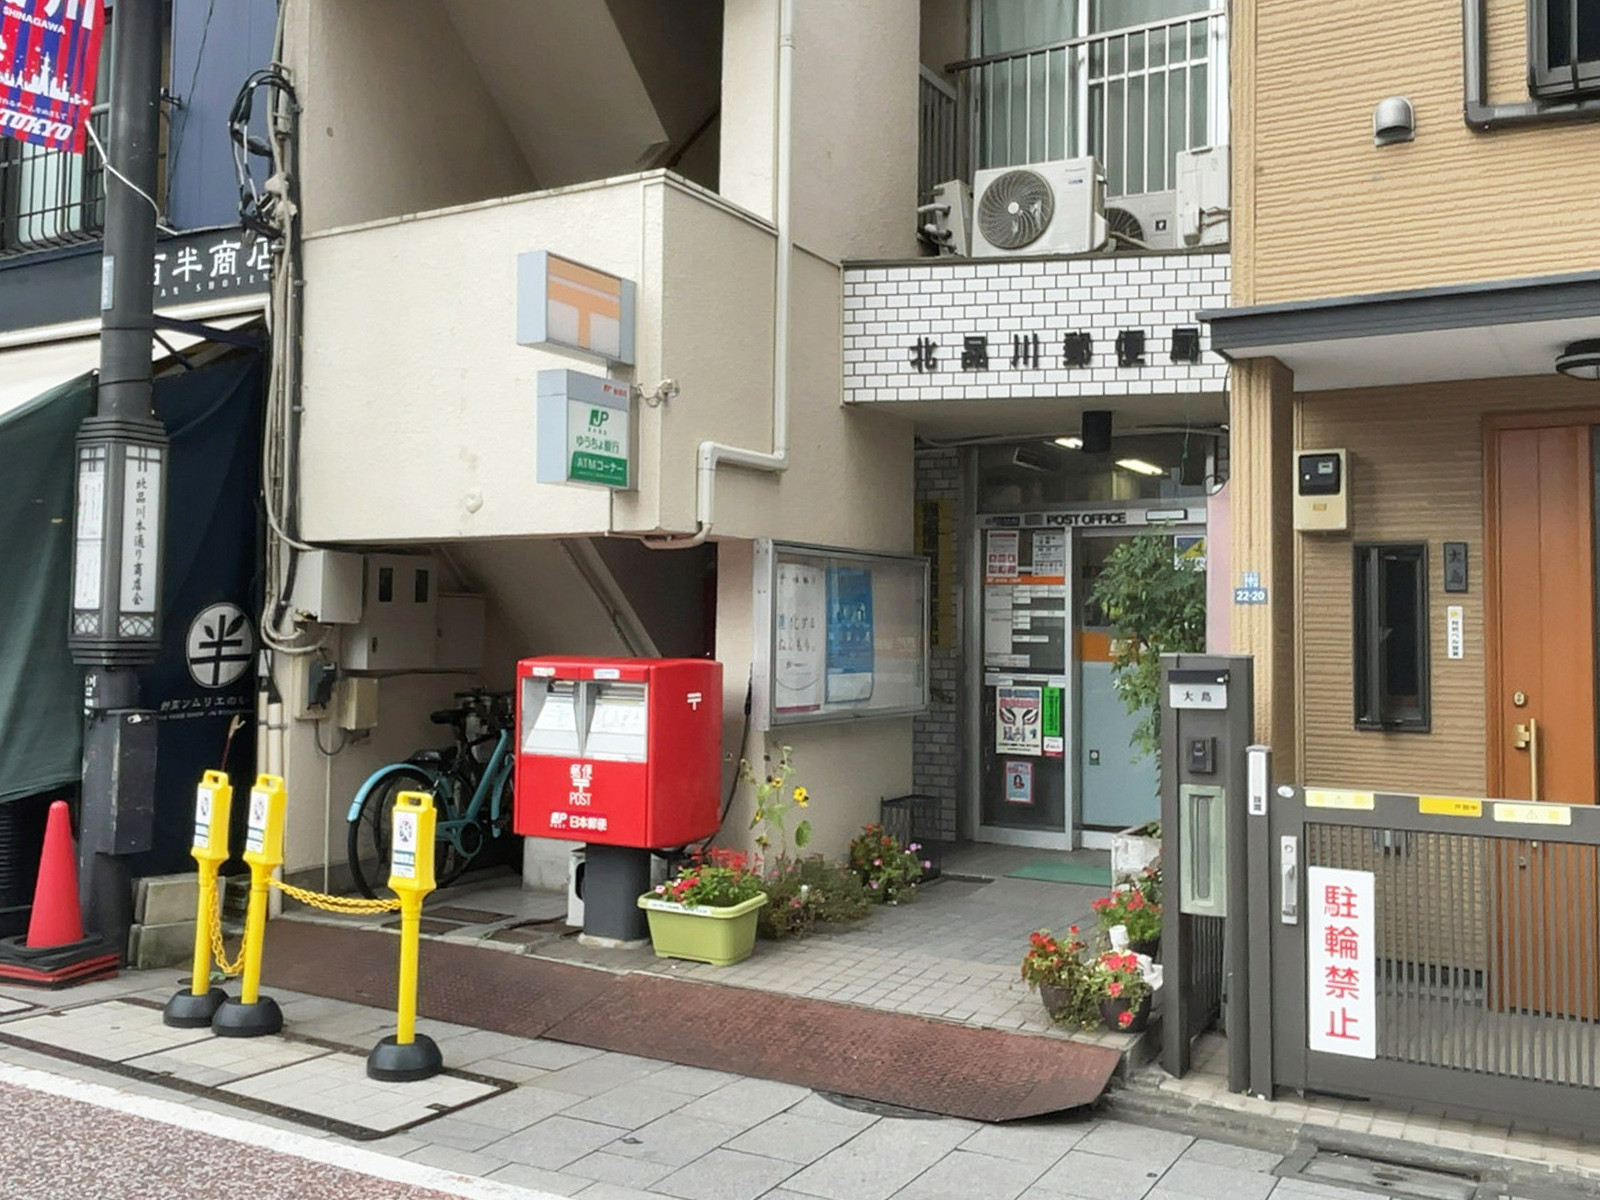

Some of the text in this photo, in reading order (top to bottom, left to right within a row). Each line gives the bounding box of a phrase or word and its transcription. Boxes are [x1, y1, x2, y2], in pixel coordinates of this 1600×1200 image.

[2, 5, 67, 35] SHINAGAWA
[0, 108, 74, 141] TOKYO
[576, 435, 620, 454] ゆうちょ銀行
[576, 457, 623, 473] ATMコーナー
[1047, 513, 1082, 525] POST
[1082, 512, 1127, 525] OFFICE
[569, 764, 593, 780] 郵便
[569, 793, 592, 806] POST
[1324, 885, 1360, 1041] 駐輪禁止
